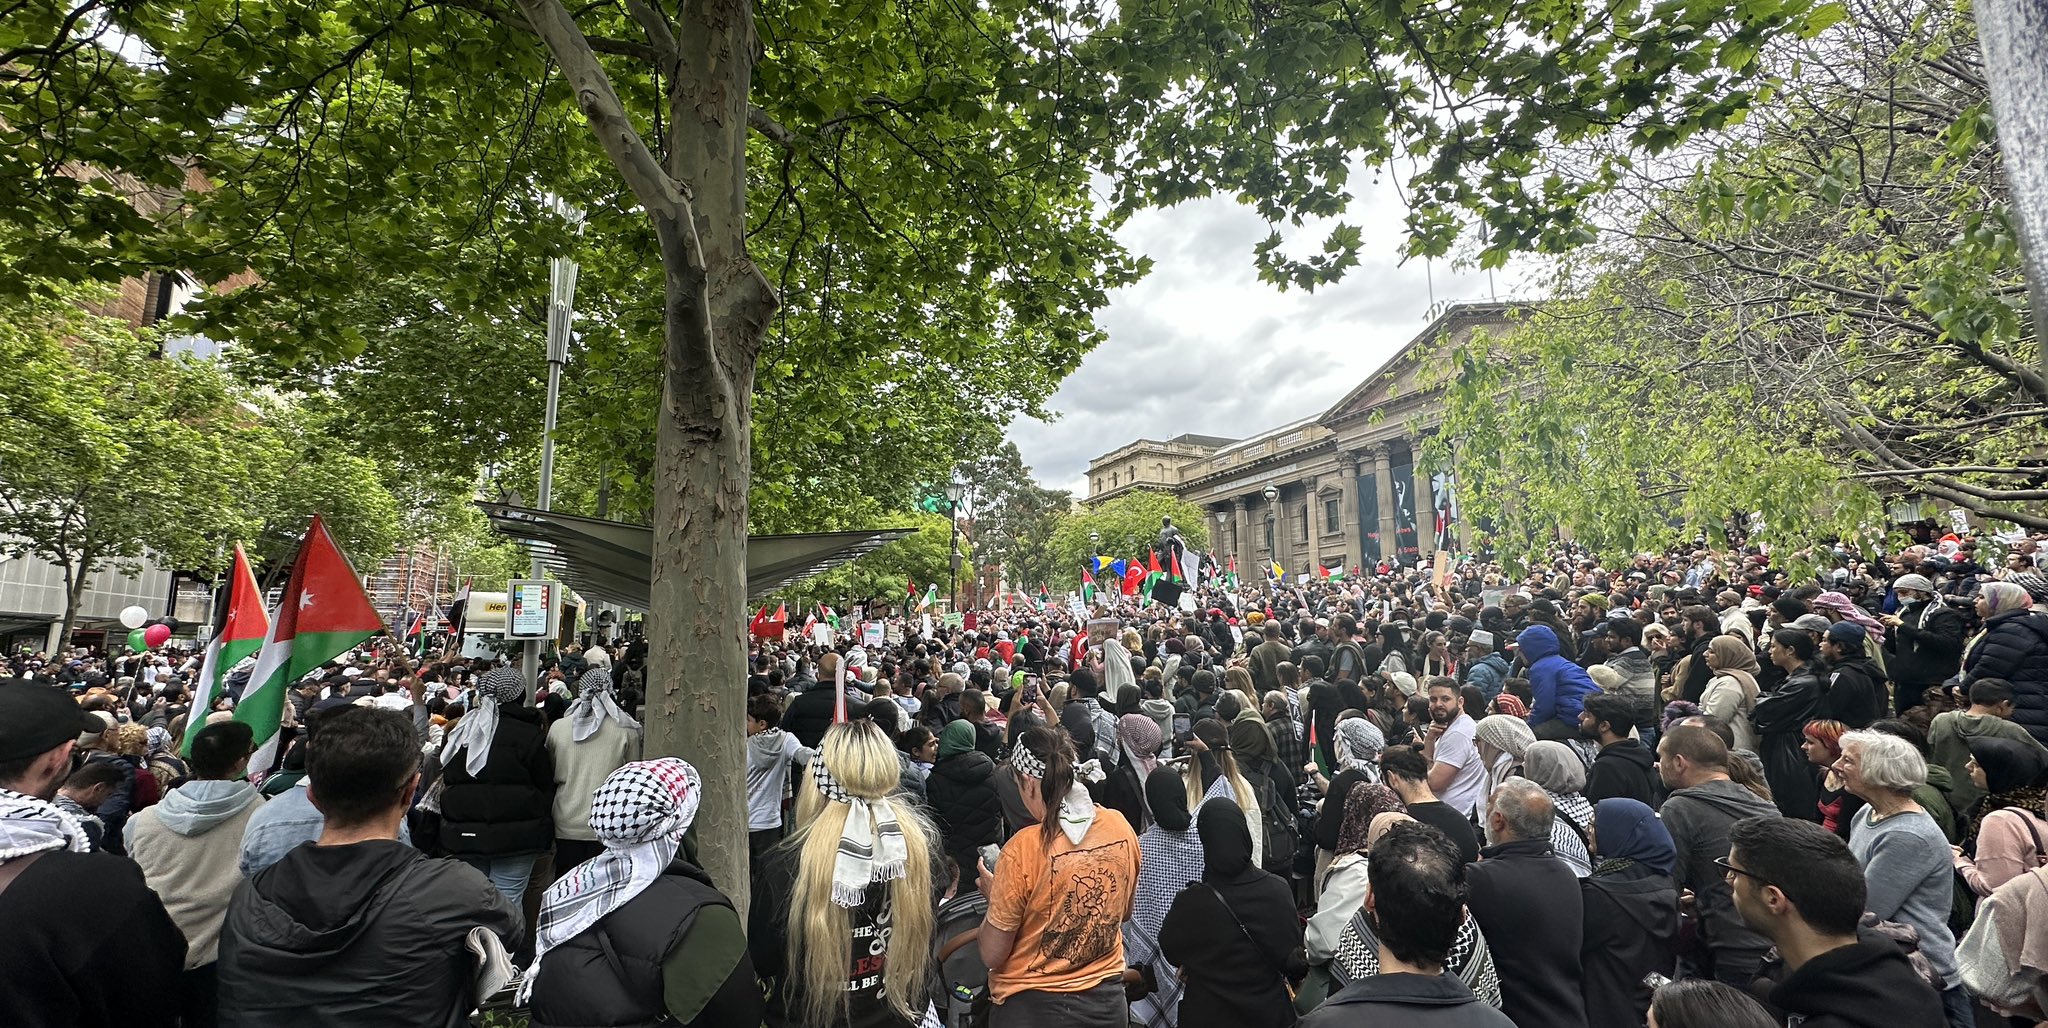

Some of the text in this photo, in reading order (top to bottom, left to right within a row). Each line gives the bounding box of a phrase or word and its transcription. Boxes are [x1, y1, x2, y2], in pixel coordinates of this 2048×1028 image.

[1254, 466, 1294, 480] LIBRARY
[1098, 868, 1117, 893] EARTH
[851, 925, 873, 938] HE
[861, 974, 879, 989] BE
